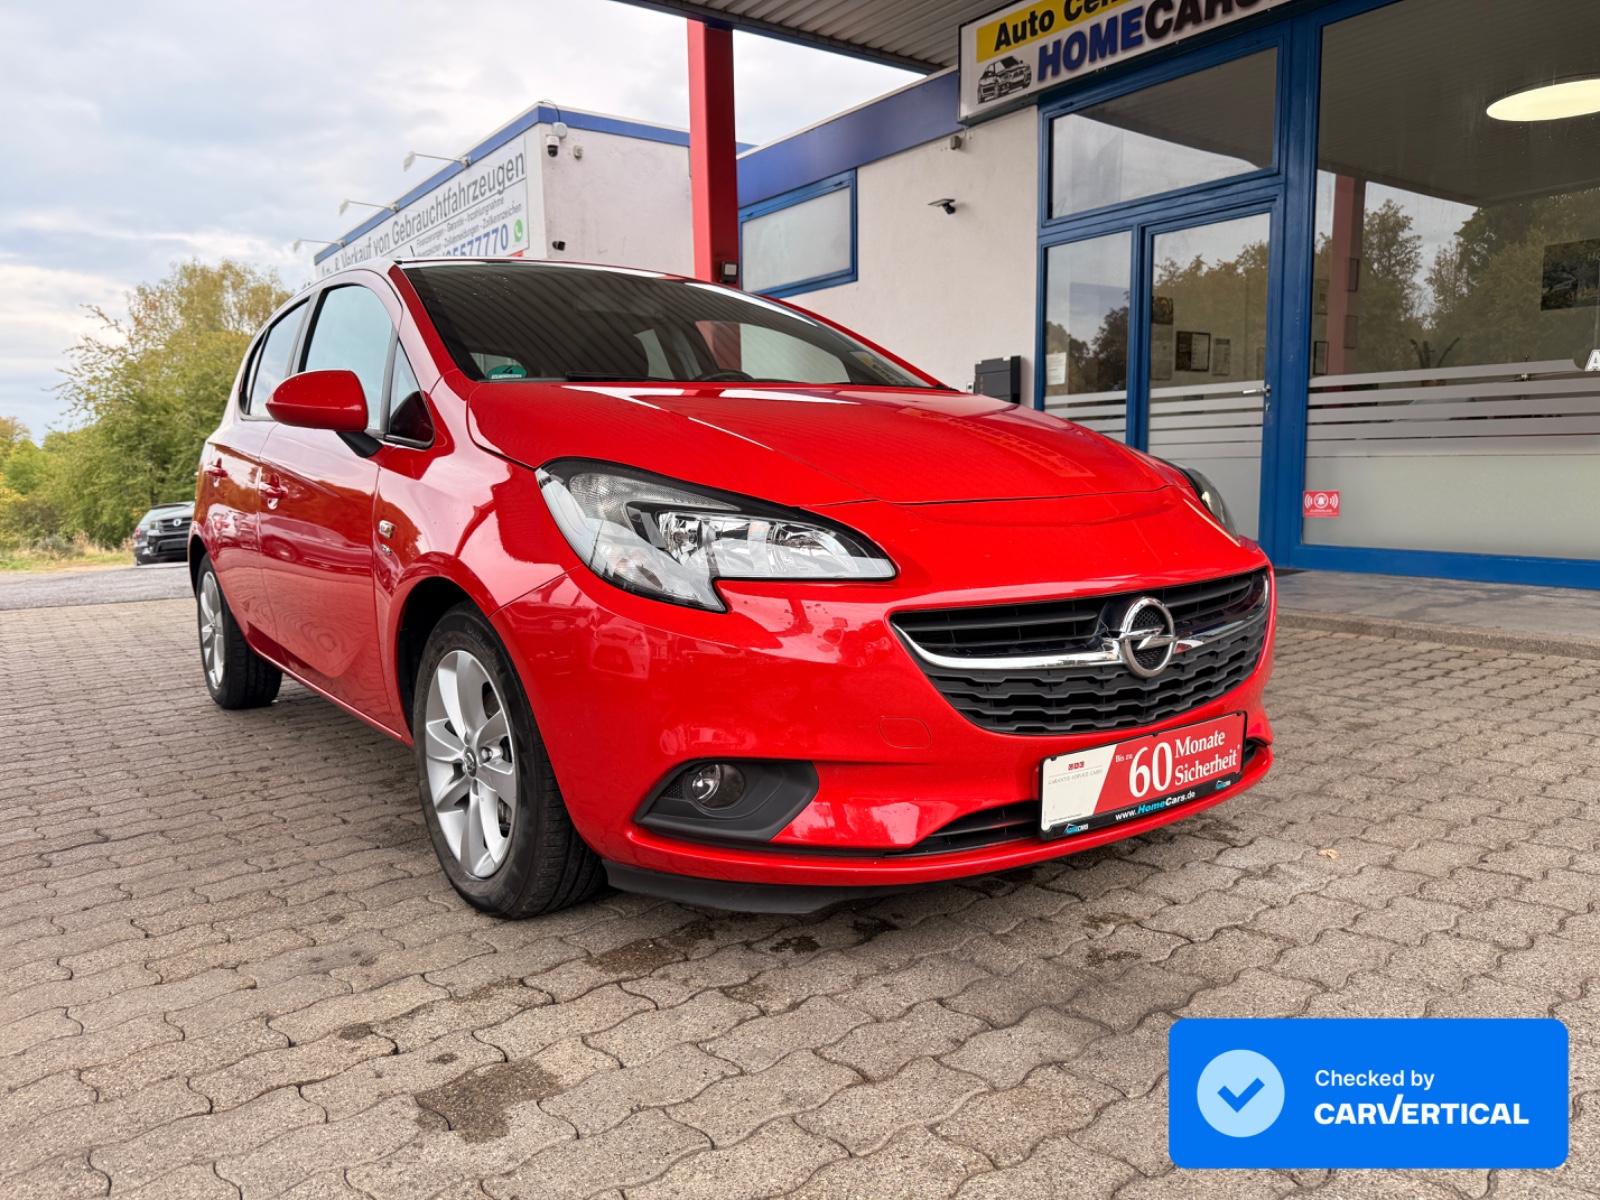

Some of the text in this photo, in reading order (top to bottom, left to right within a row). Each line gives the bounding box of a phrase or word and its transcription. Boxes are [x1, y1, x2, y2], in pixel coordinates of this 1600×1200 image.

[993, 10, 1055, 52] Auto
[341, 236, 372, 267] Verkauf
[373, 232, 391, 255] von
[391, 152, 525, 246] Gebrauchtfahrzeugen
[1174, 730, 1226, 759] Monate
[1129, 741, 1173, 798] 60
